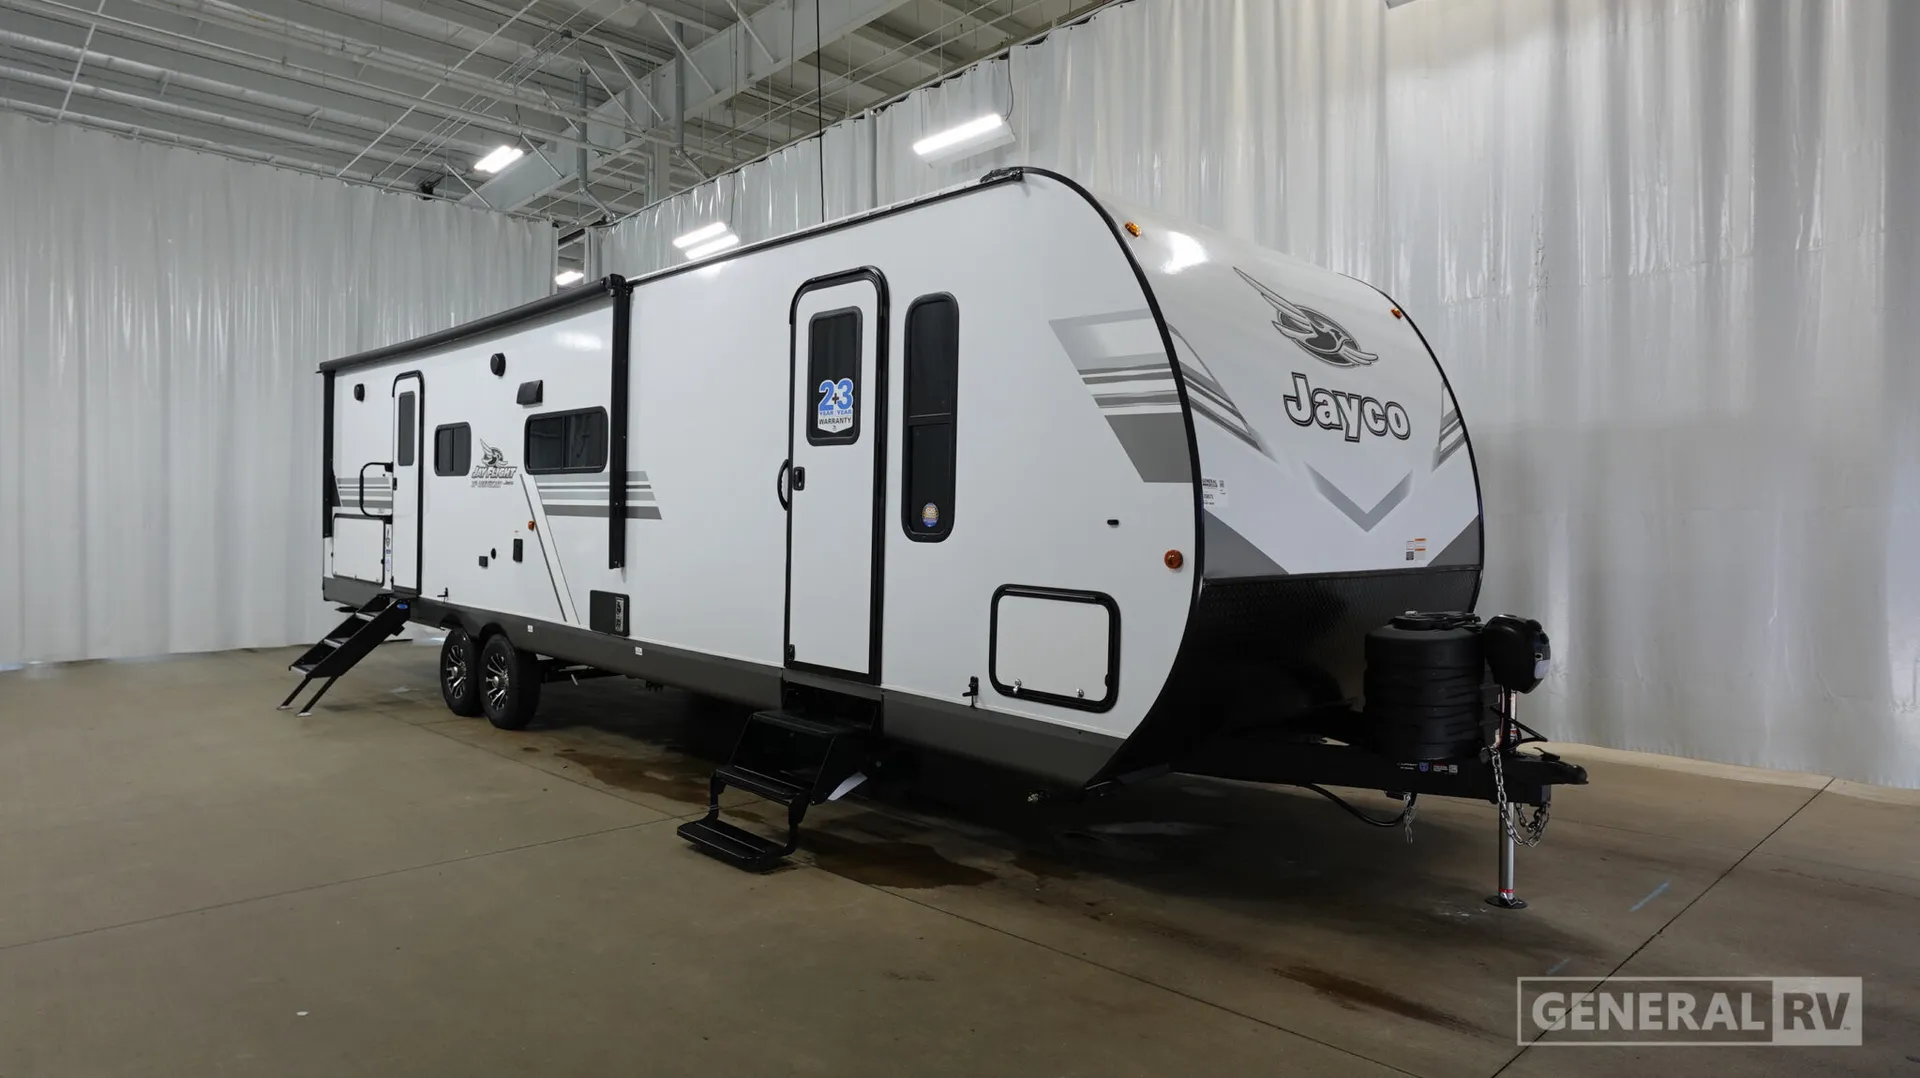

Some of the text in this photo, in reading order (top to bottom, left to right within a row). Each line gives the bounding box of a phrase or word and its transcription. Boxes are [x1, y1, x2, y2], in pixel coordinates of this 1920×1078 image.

[1283, 371, 1411, 443] Jayco
[819, 417, 851, 425] WARRANTY
[486, 466, 517, 478] FLIGHT
